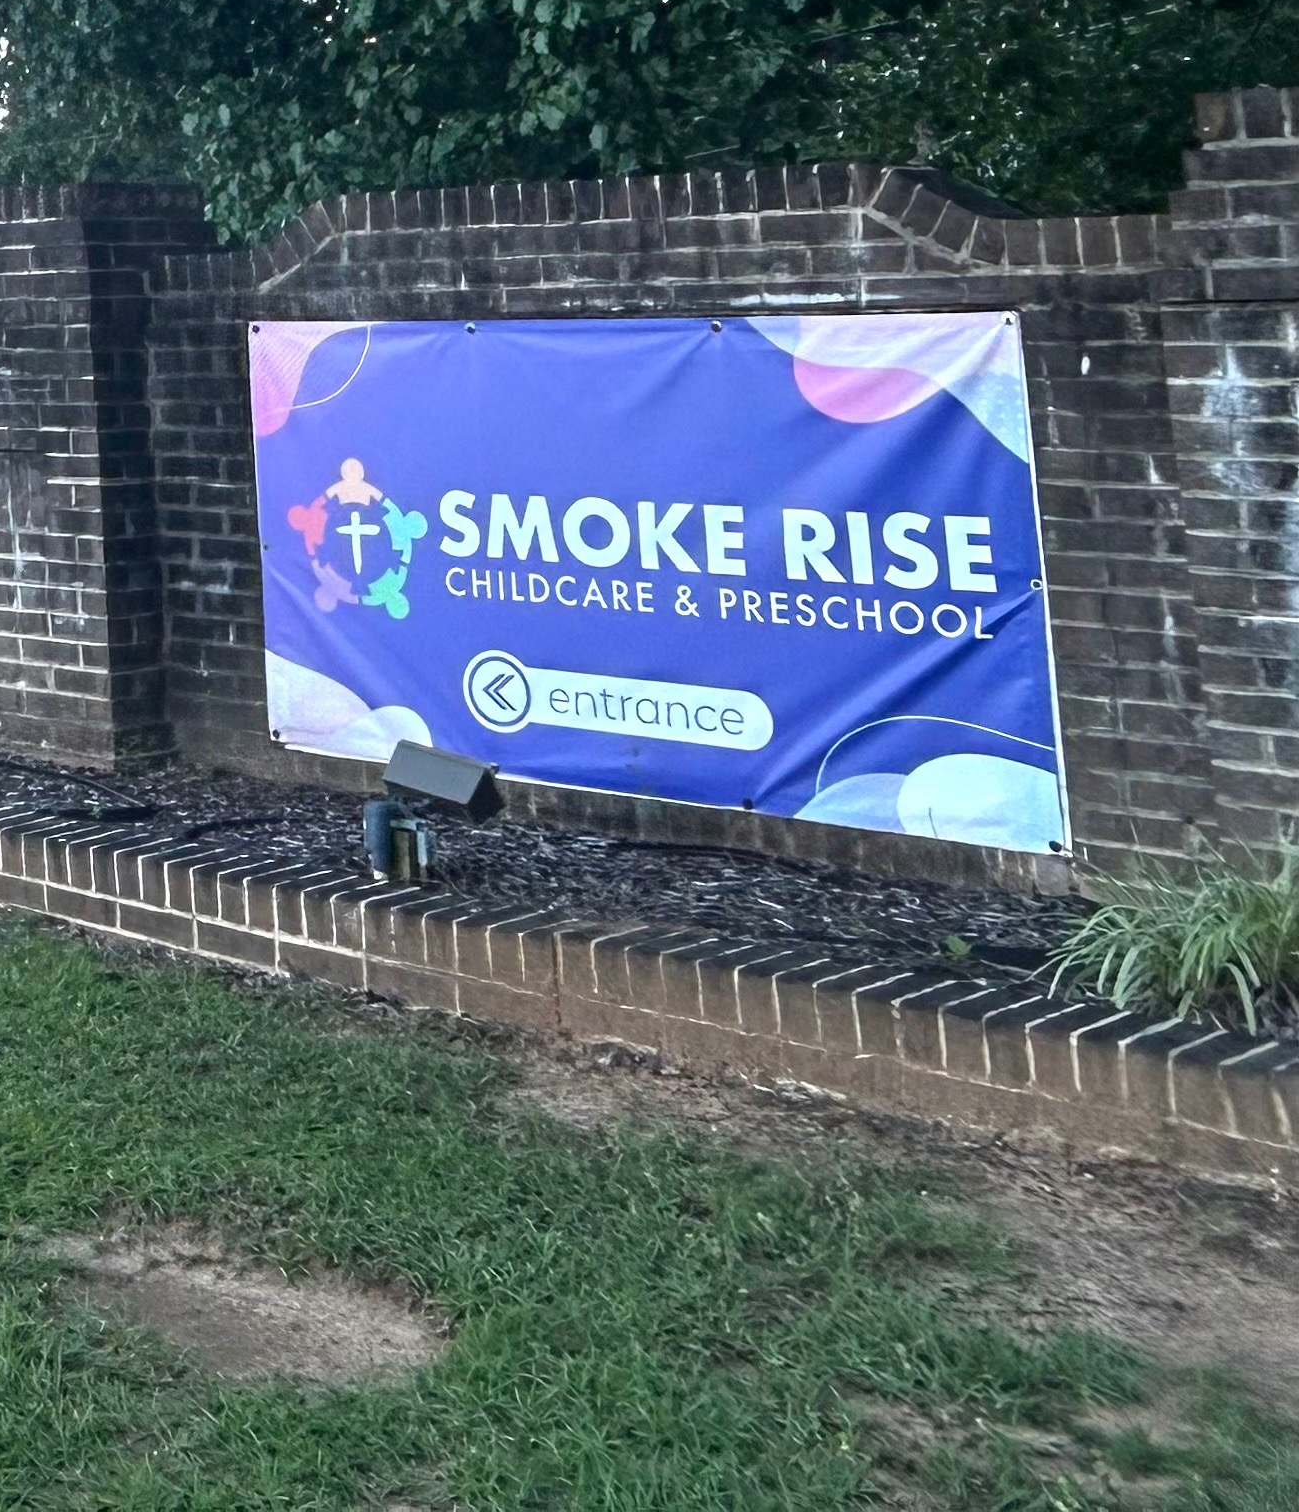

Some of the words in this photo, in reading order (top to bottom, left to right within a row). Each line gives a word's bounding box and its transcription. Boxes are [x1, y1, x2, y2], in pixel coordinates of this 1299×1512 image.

[439, 490, 746, 576] SMOKE
[783, 508, 997, 592] RISE
[445, 567, 654, 613] CHILDCARE
[675, 585, 701, 618] &
[721, 589, 994, 640] PRESCHOOL
[549, 683, 745, 736] entrance
